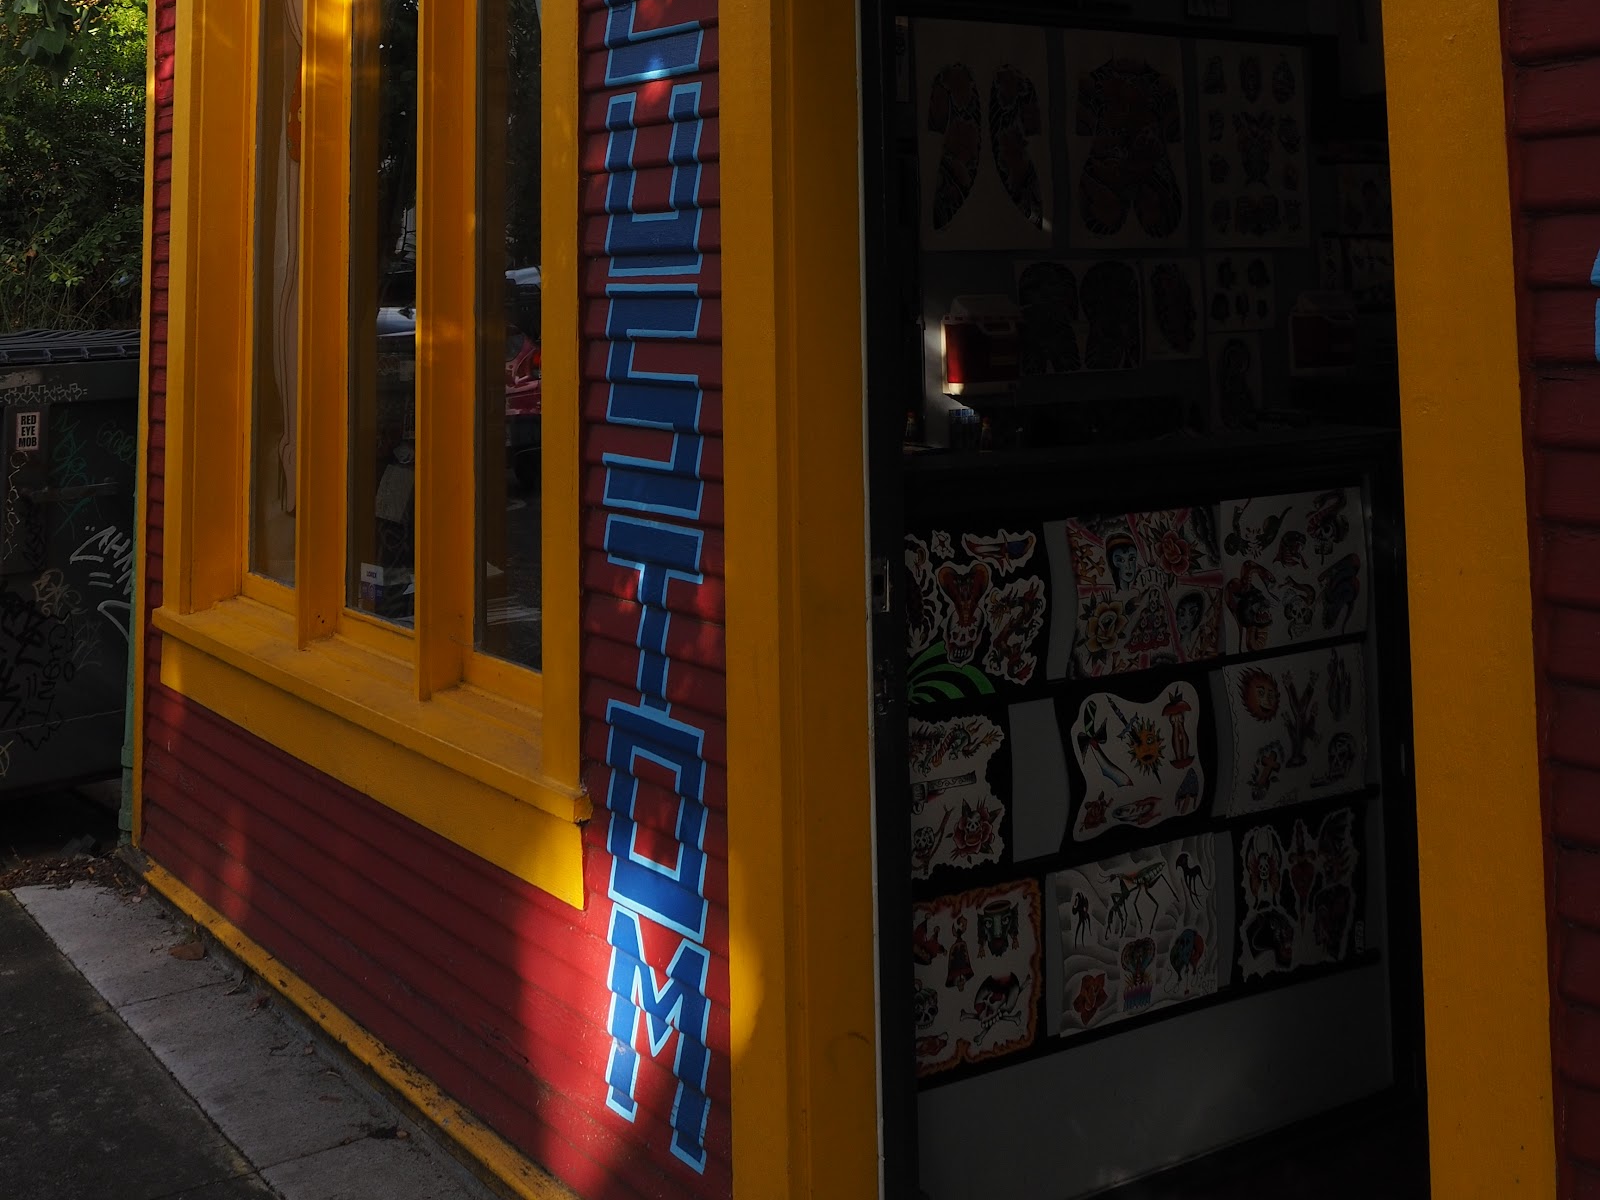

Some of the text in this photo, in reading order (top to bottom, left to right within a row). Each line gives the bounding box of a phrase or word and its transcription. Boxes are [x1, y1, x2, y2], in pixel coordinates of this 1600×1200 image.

[20, 415, 37, 425] RED
[21, 426, 36, 437] EYE
[18, 437, 37, 448] MOB
